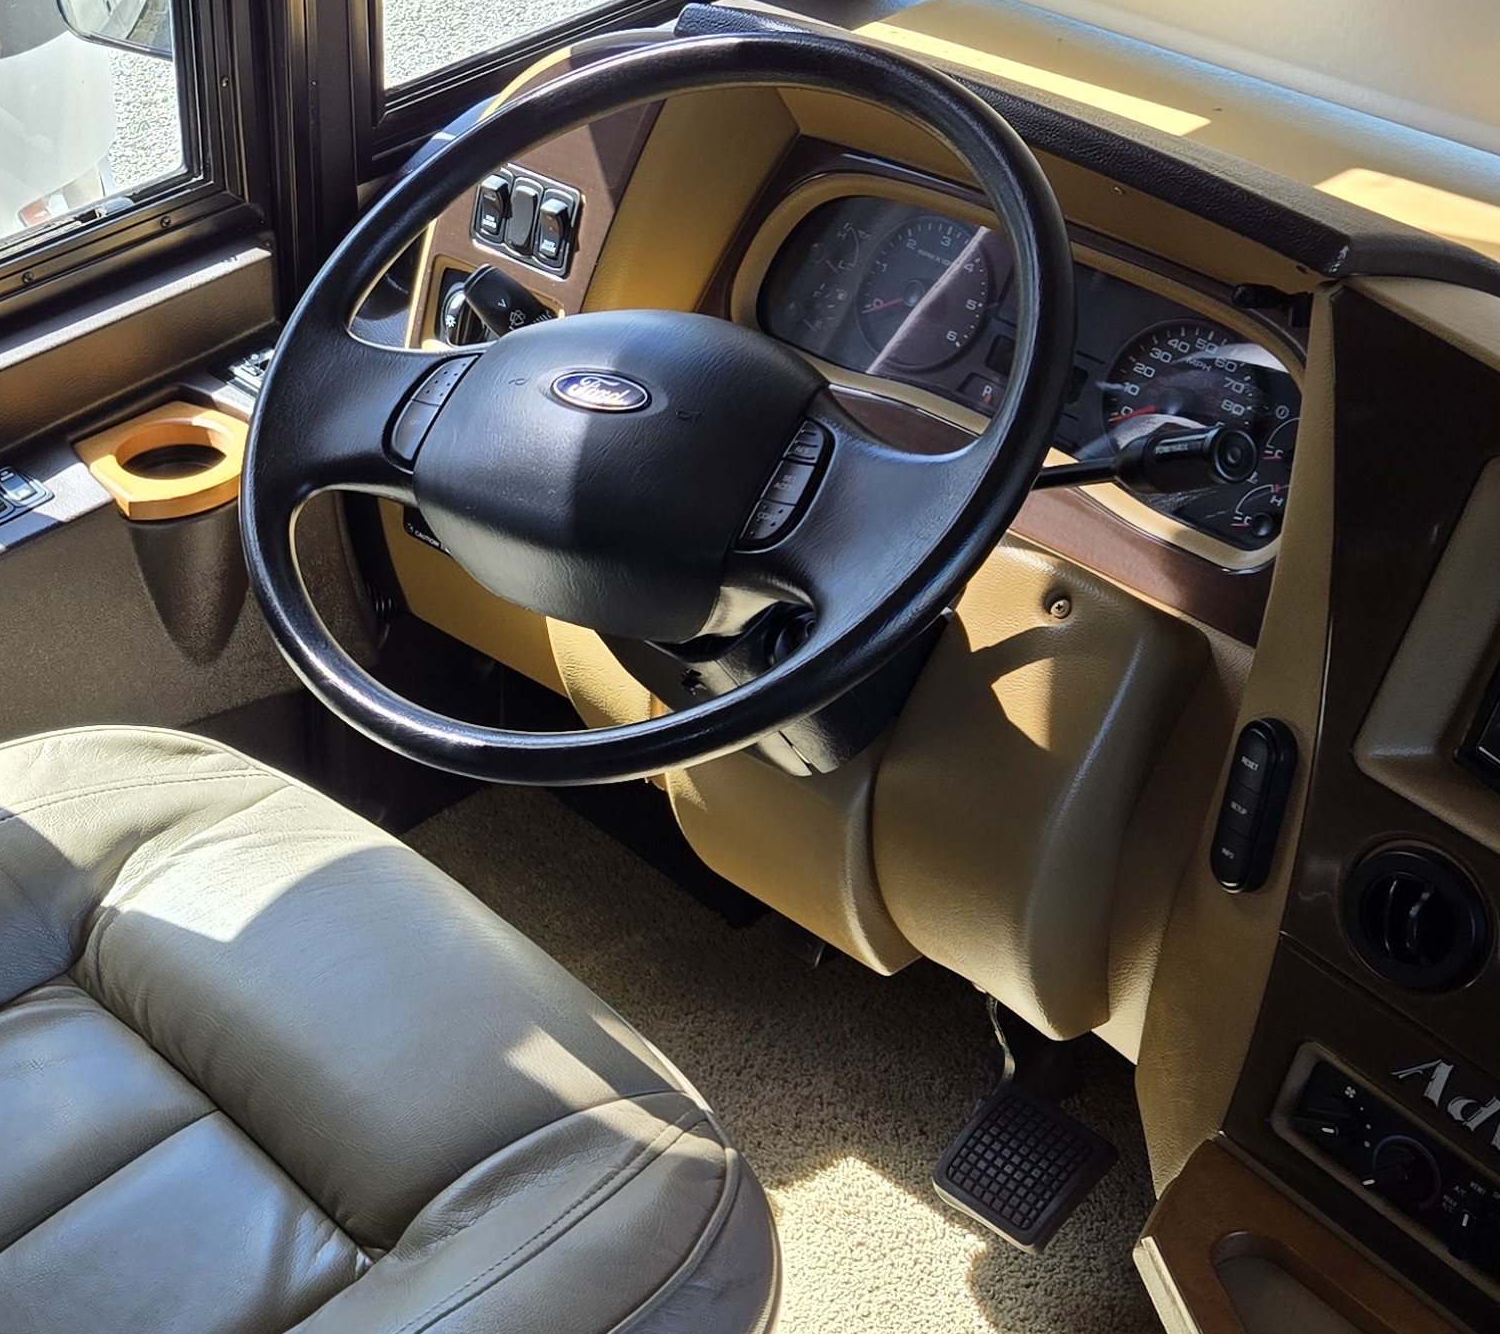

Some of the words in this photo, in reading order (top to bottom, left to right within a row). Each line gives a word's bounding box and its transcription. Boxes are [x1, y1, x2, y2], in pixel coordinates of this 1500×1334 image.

[906, 238, 918, 250] 2
[941, 235, 952, 247] 3
[963, 262, 975, 273] 4
[965, 298, 977, 311] 5
[946, 329, 958, 342] 6
[1167, 338, 1191, 354] 40
[1194, 337, 1218, 355] 50
[1149, 347, 1173, 364] 30
[1132, 361, 1156, 378] 20
[1185, 357, 1212, 372] MPH
[1214, 356, 1238, 373] 60
[567, 375, 630, 407] Ford
[1123, 380, 1141, 397] 10
[1223, 376, 1245, 394] 70
[1220, 398, 1246, 416] 80
[1269, 495, 1284, 507] H
[1470, 1180, 1487, 1196] VENT
